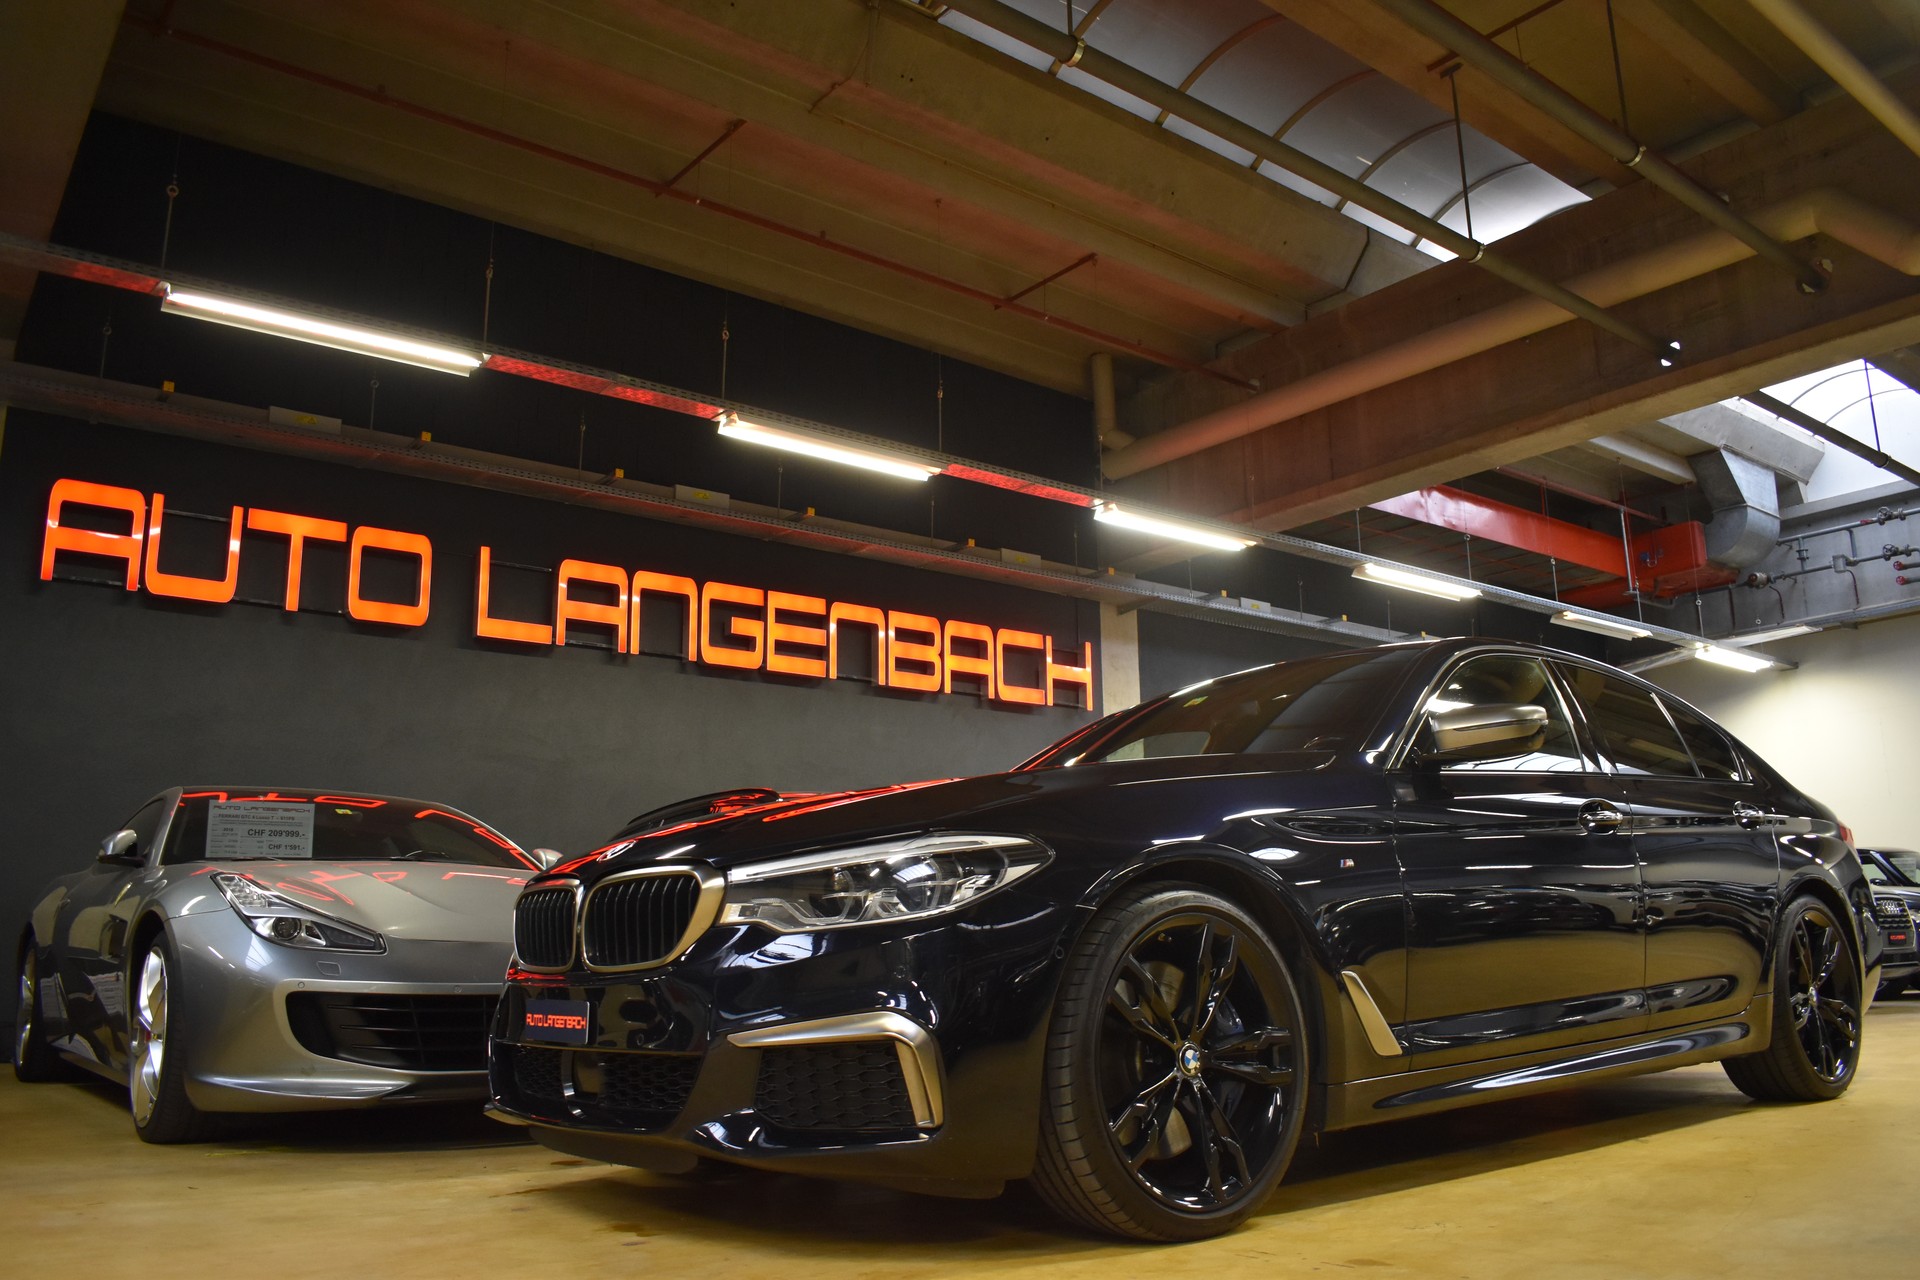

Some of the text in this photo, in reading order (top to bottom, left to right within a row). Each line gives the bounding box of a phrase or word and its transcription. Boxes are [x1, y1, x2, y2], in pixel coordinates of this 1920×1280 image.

[41, 478, 1093, 711] AUTO LANGENBACH
[247, 828, 266, 837] CHF
[268, 829, 305, 838] 209'999.-
[526, 1013, 586, 1029] AUTO LANGENBACH
